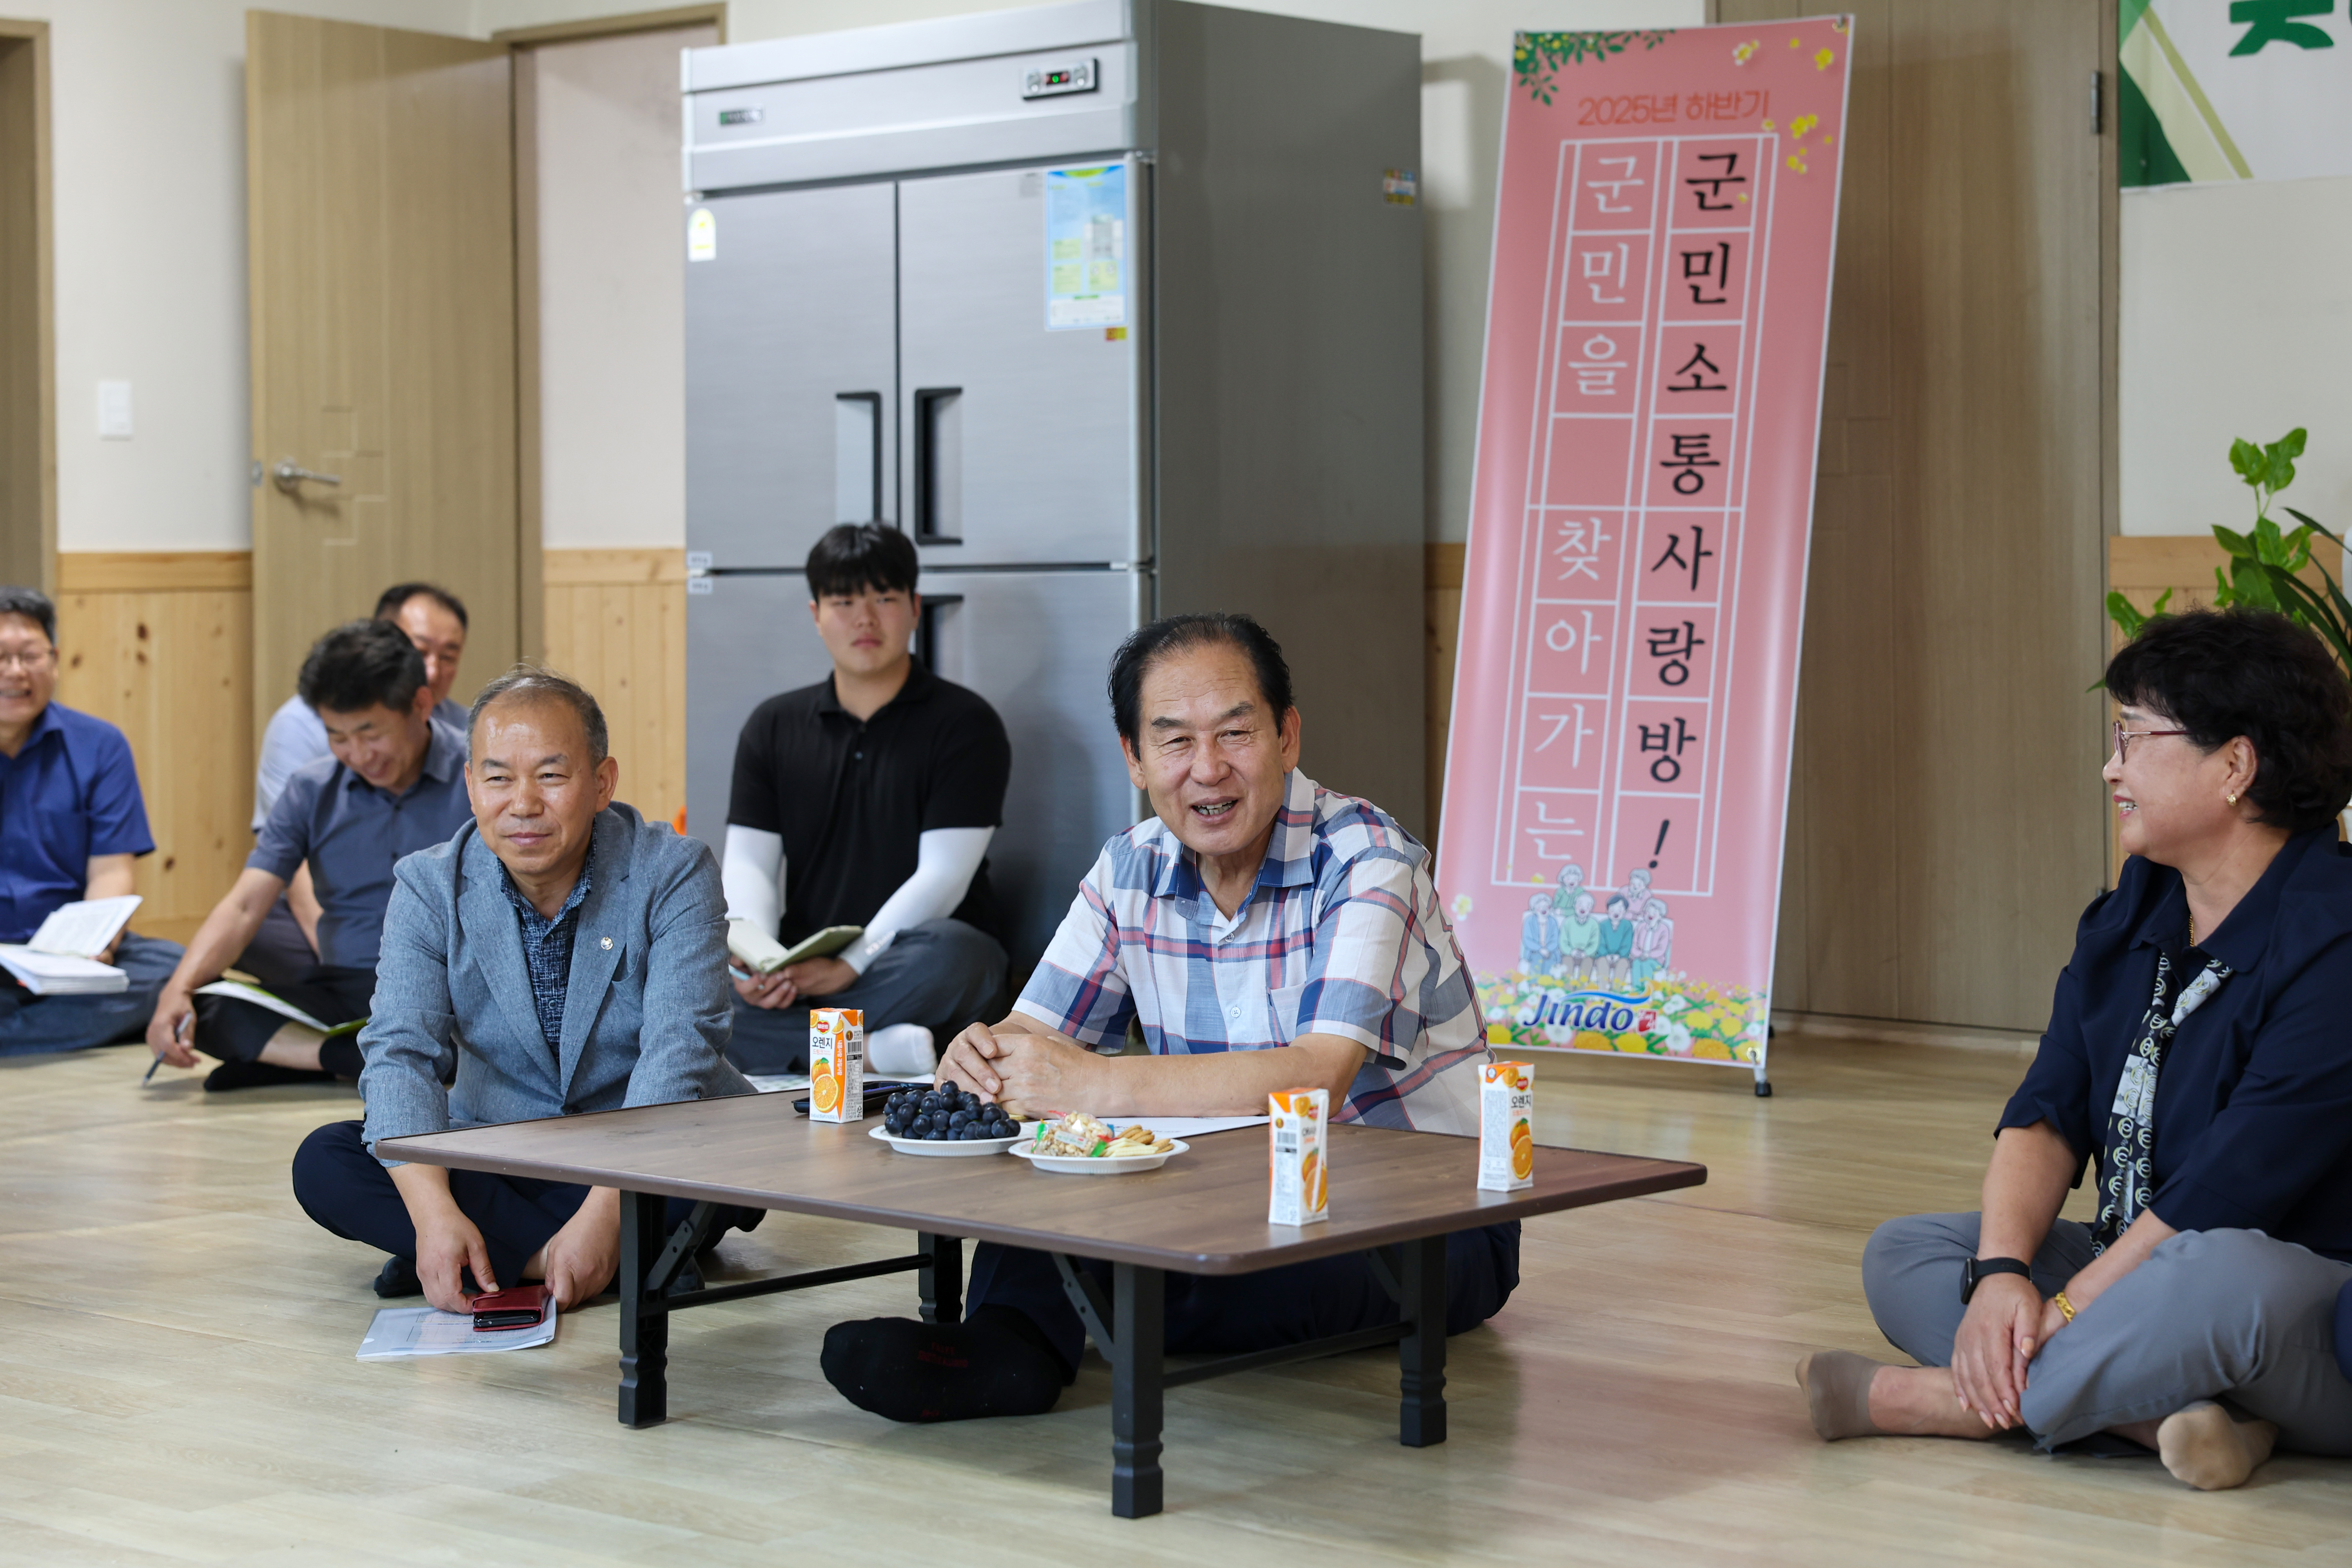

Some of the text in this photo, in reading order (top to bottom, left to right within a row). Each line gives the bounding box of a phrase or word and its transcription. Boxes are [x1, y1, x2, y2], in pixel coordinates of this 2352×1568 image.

[1578, 89, 1769, 127] 2025년 하반기
[1525, 156, 1644, 860] 군민을 찾아가는
[1523, 995, 1633, 1031] Jindo
[812, 1036, 833, 1049] 오렌지
